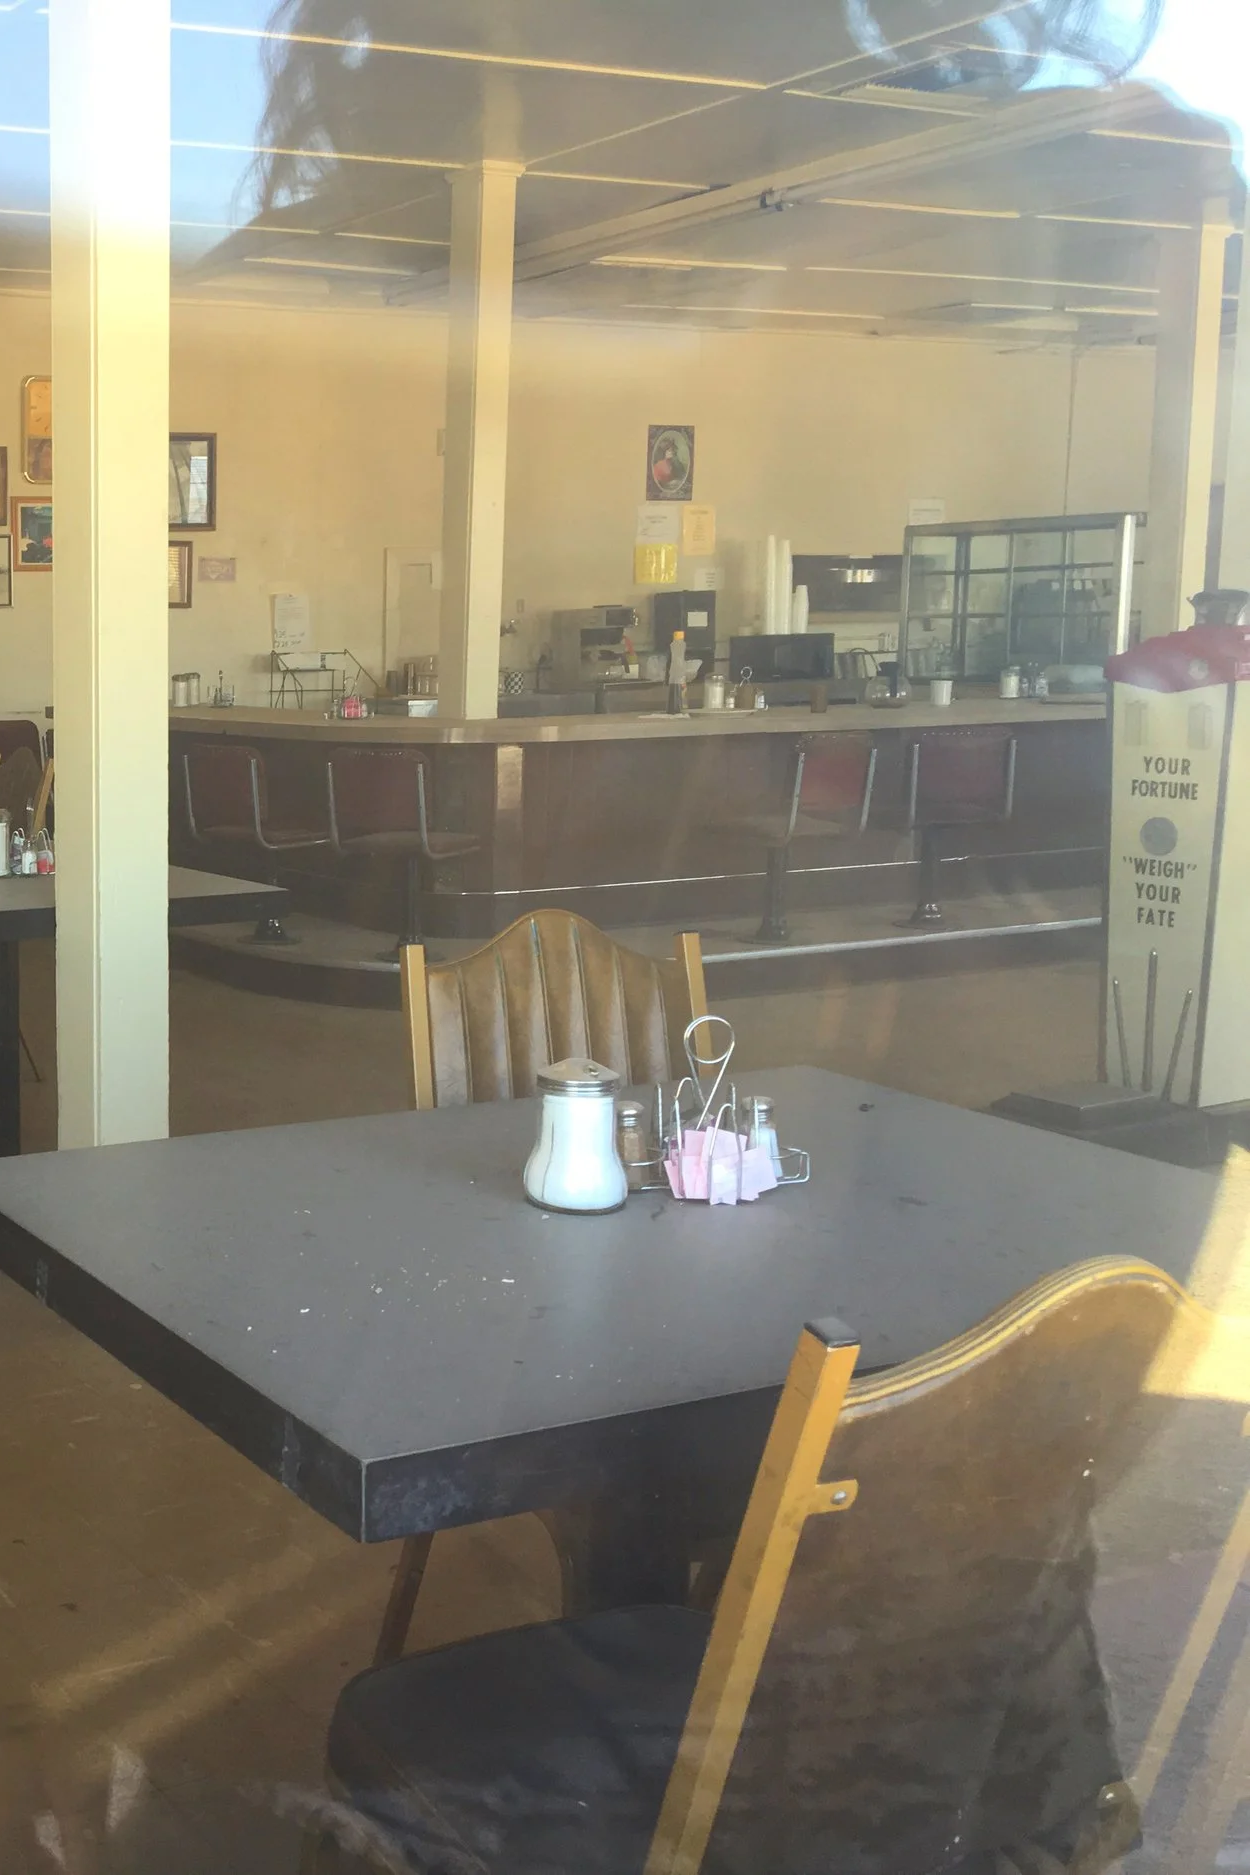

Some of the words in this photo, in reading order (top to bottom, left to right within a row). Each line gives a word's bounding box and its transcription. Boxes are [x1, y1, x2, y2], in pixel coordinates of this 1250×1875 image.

[1143, 756, 1191, 776] YOUR
[1131, 779, 1199, 801] FORTUNE
[1135, 882, 1181, 904] YOUR
[1137, 907, 1175, 928] FATE
